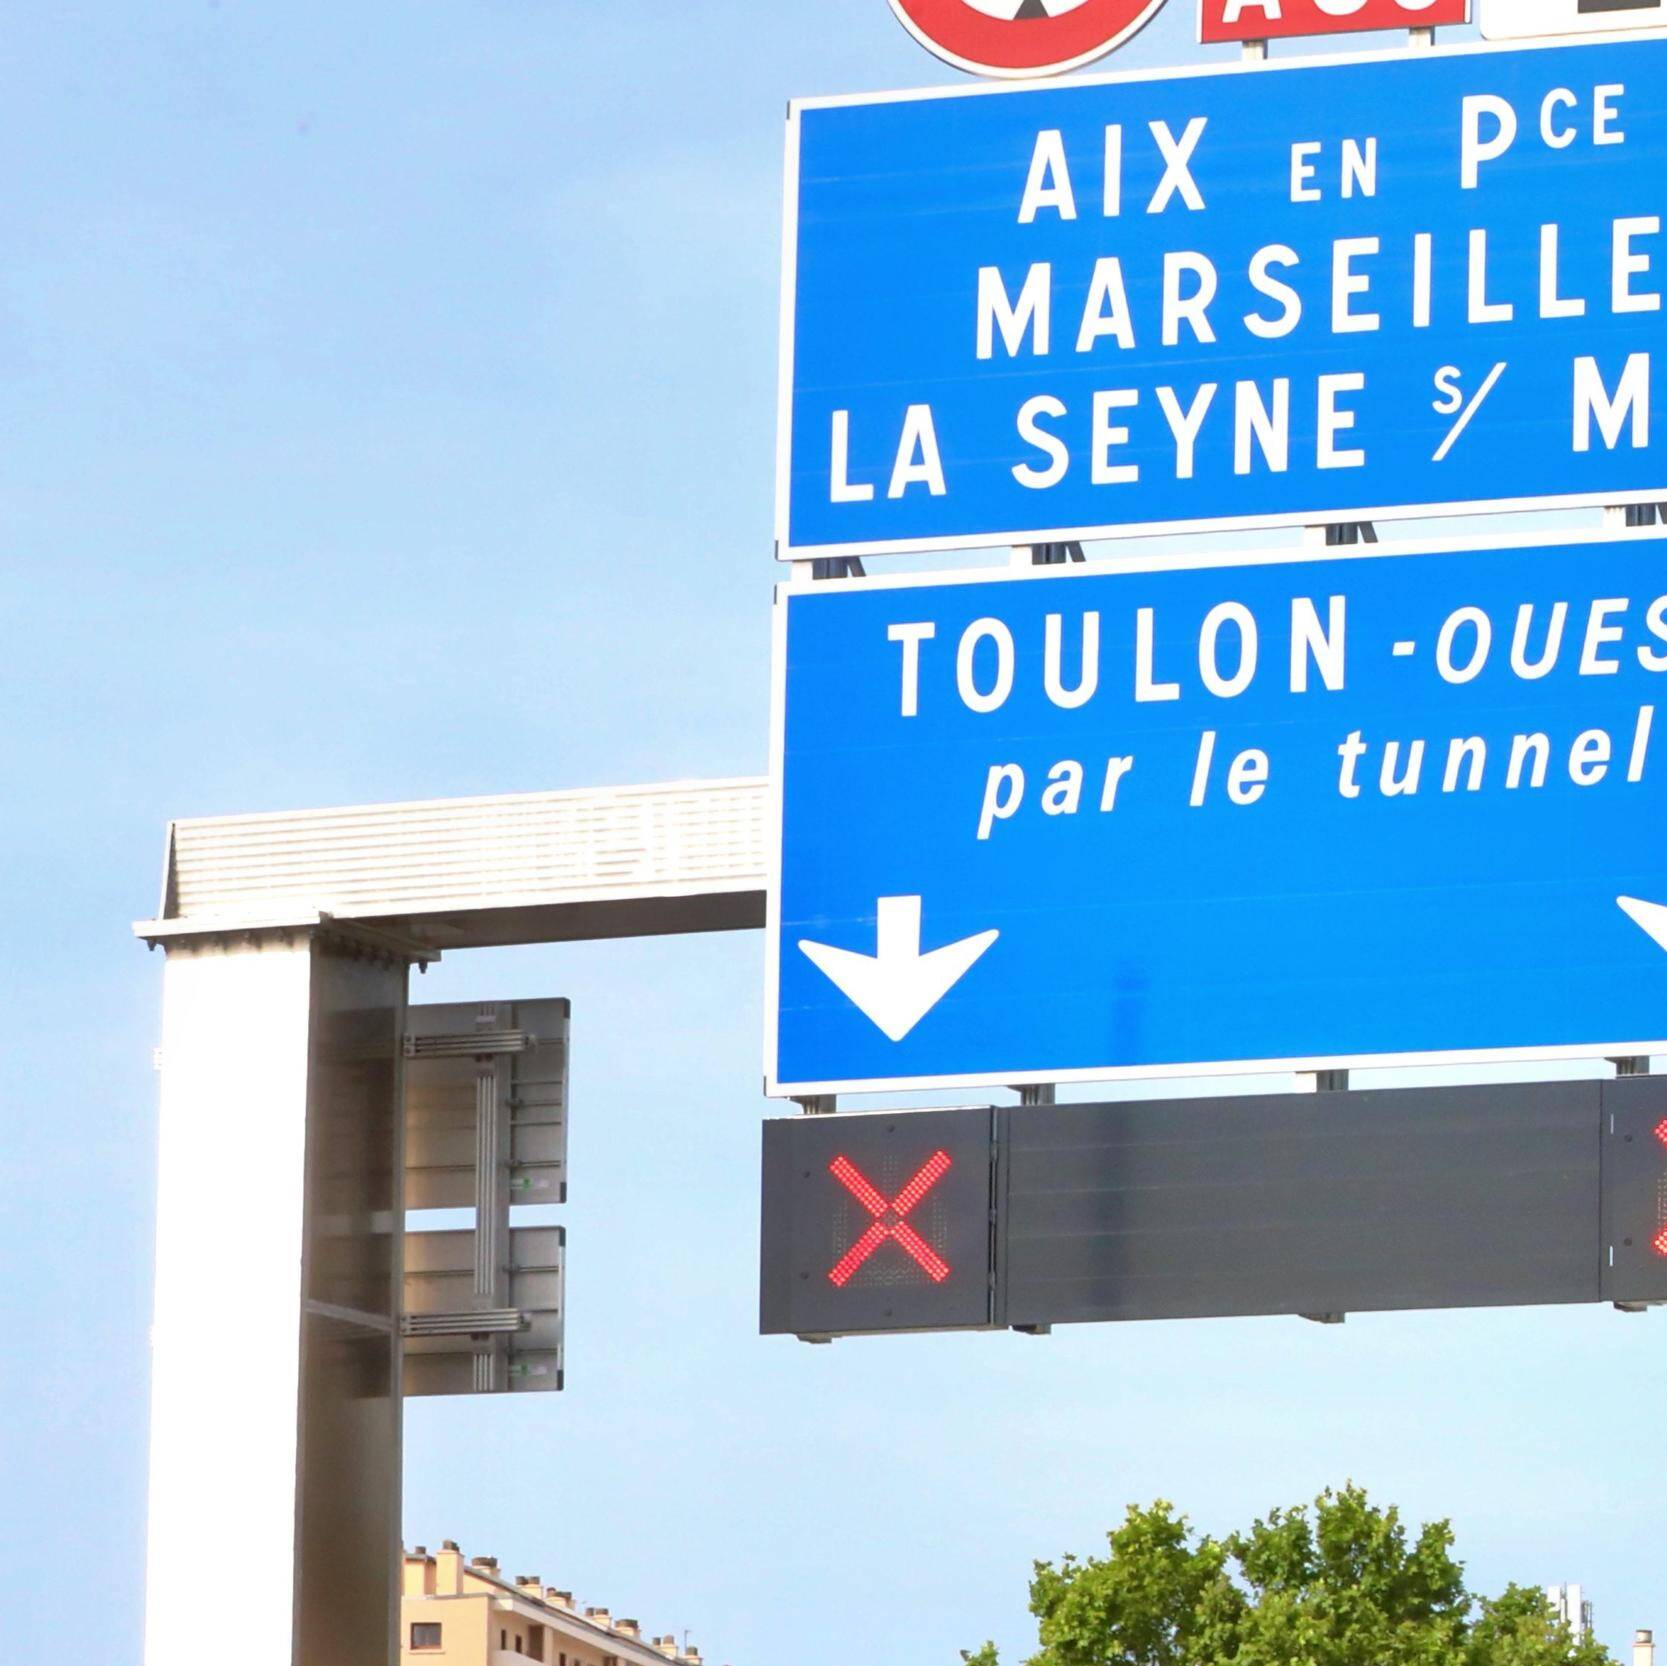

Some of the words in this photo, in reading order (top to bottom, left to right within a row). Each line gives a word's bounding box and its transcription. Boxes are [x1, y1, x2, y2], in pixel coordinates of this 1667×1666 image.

[1017, 117, 1208, 224] AIX
[1290, 137, 1377, 202] EN
[976, 215, 1661, 360] MARSEILLE
[829, 403, 947, 503] LA
[1011, 372, 1366, 490] SEYNE
[976, 755, 1134, 840] par
[1189, 729, 1270, 807] le
[1336, 705, 1655, 799] tunnel
